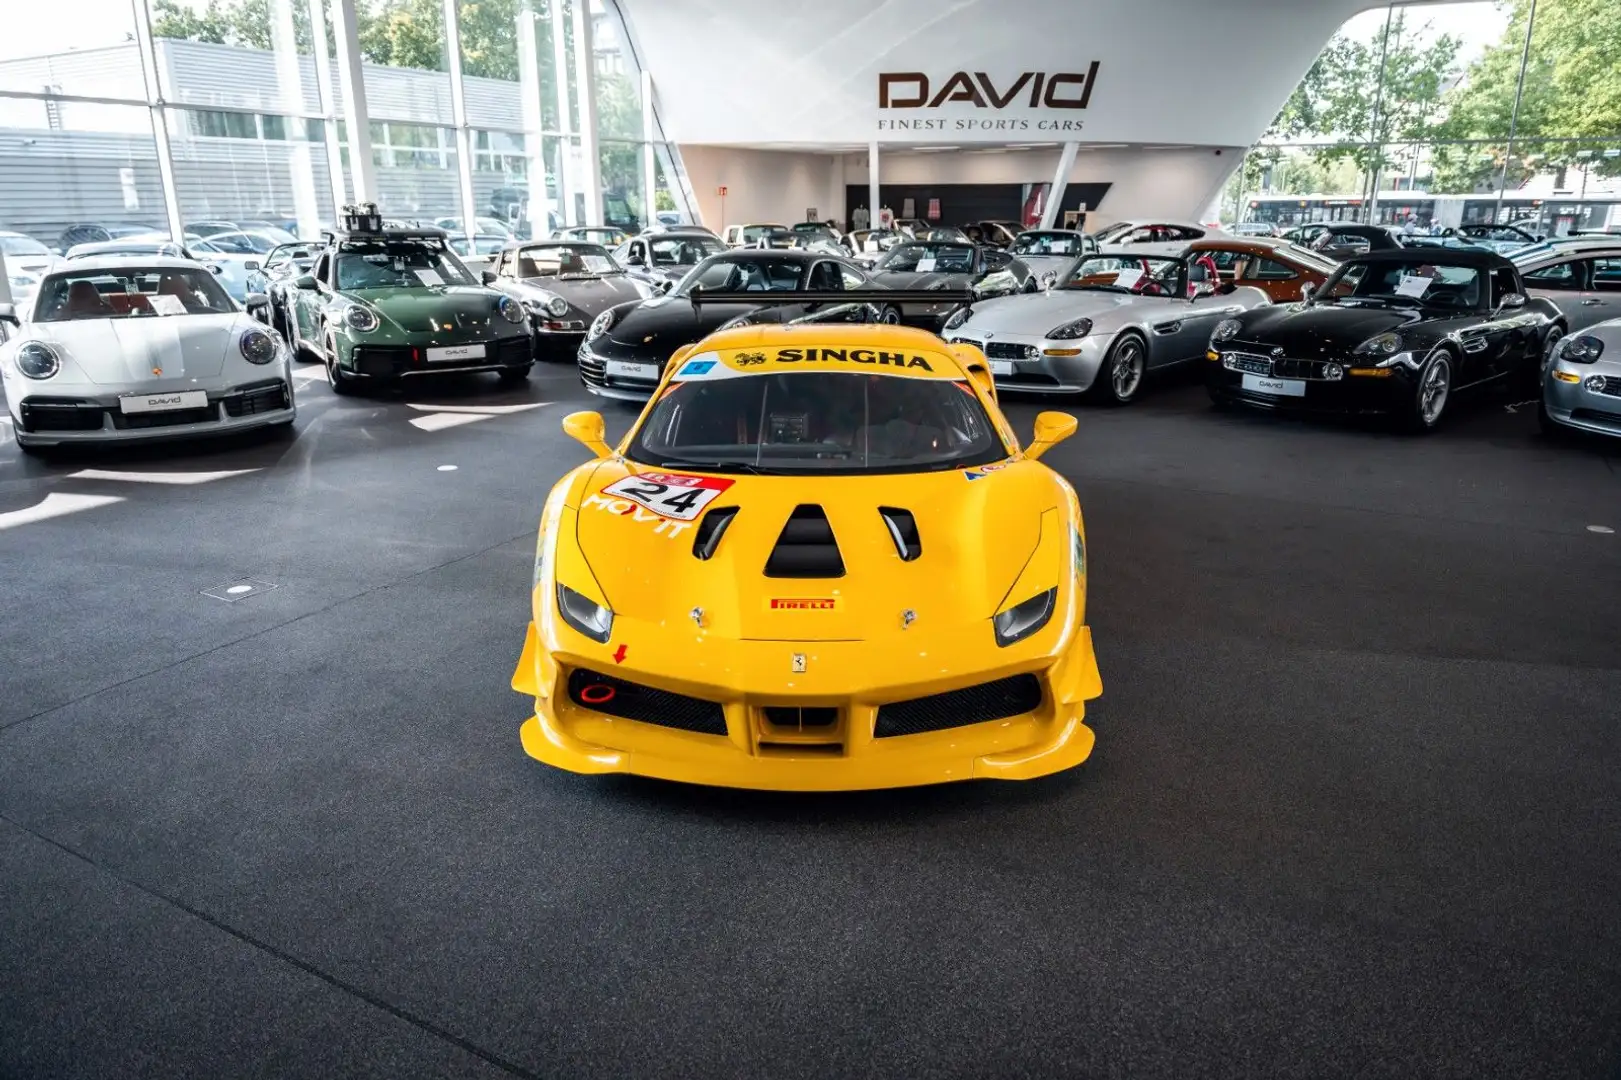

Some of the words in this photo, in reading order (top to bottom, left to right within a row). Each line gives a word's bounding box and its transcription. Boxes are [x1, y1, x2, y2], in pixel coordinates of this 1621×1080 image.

[877, 118, 948, 131] FINEST
[955, 118, 1030, 131] SPORTS
[1037, 119, 1085, 131] CARS
[775, 348, 935, 373] SINGHA
[619, 481, 706, 514] 24
[770, 598, 836, 609] PIRELLI
